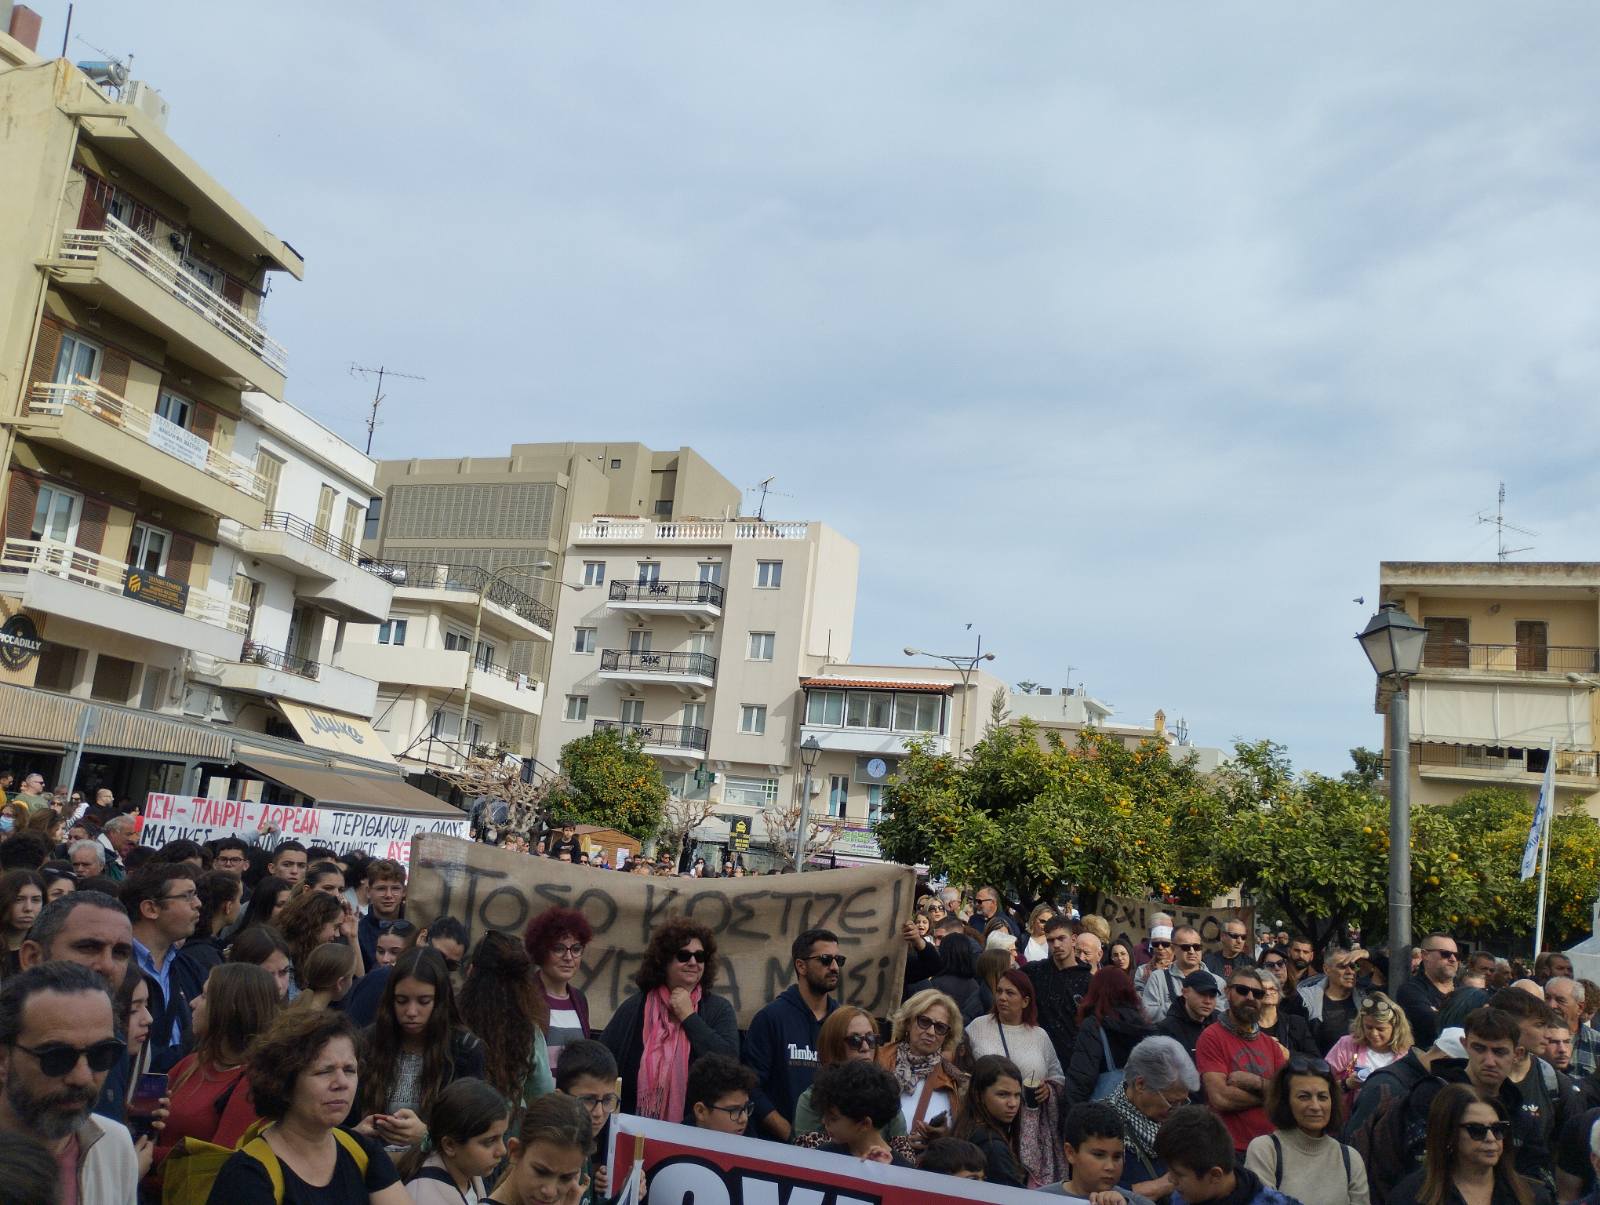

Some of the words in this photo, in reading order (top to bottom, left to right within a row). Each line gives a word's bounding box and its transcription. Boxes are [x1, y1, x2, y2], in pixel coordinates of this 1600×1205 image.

[146, 794, 175, 821] ΙΣΗ
[192, 797, 246, 829] ΠΛΗΡΗ
[332, 812, 410, 840] ΠΕΡΙΘΑΛΨΗ
